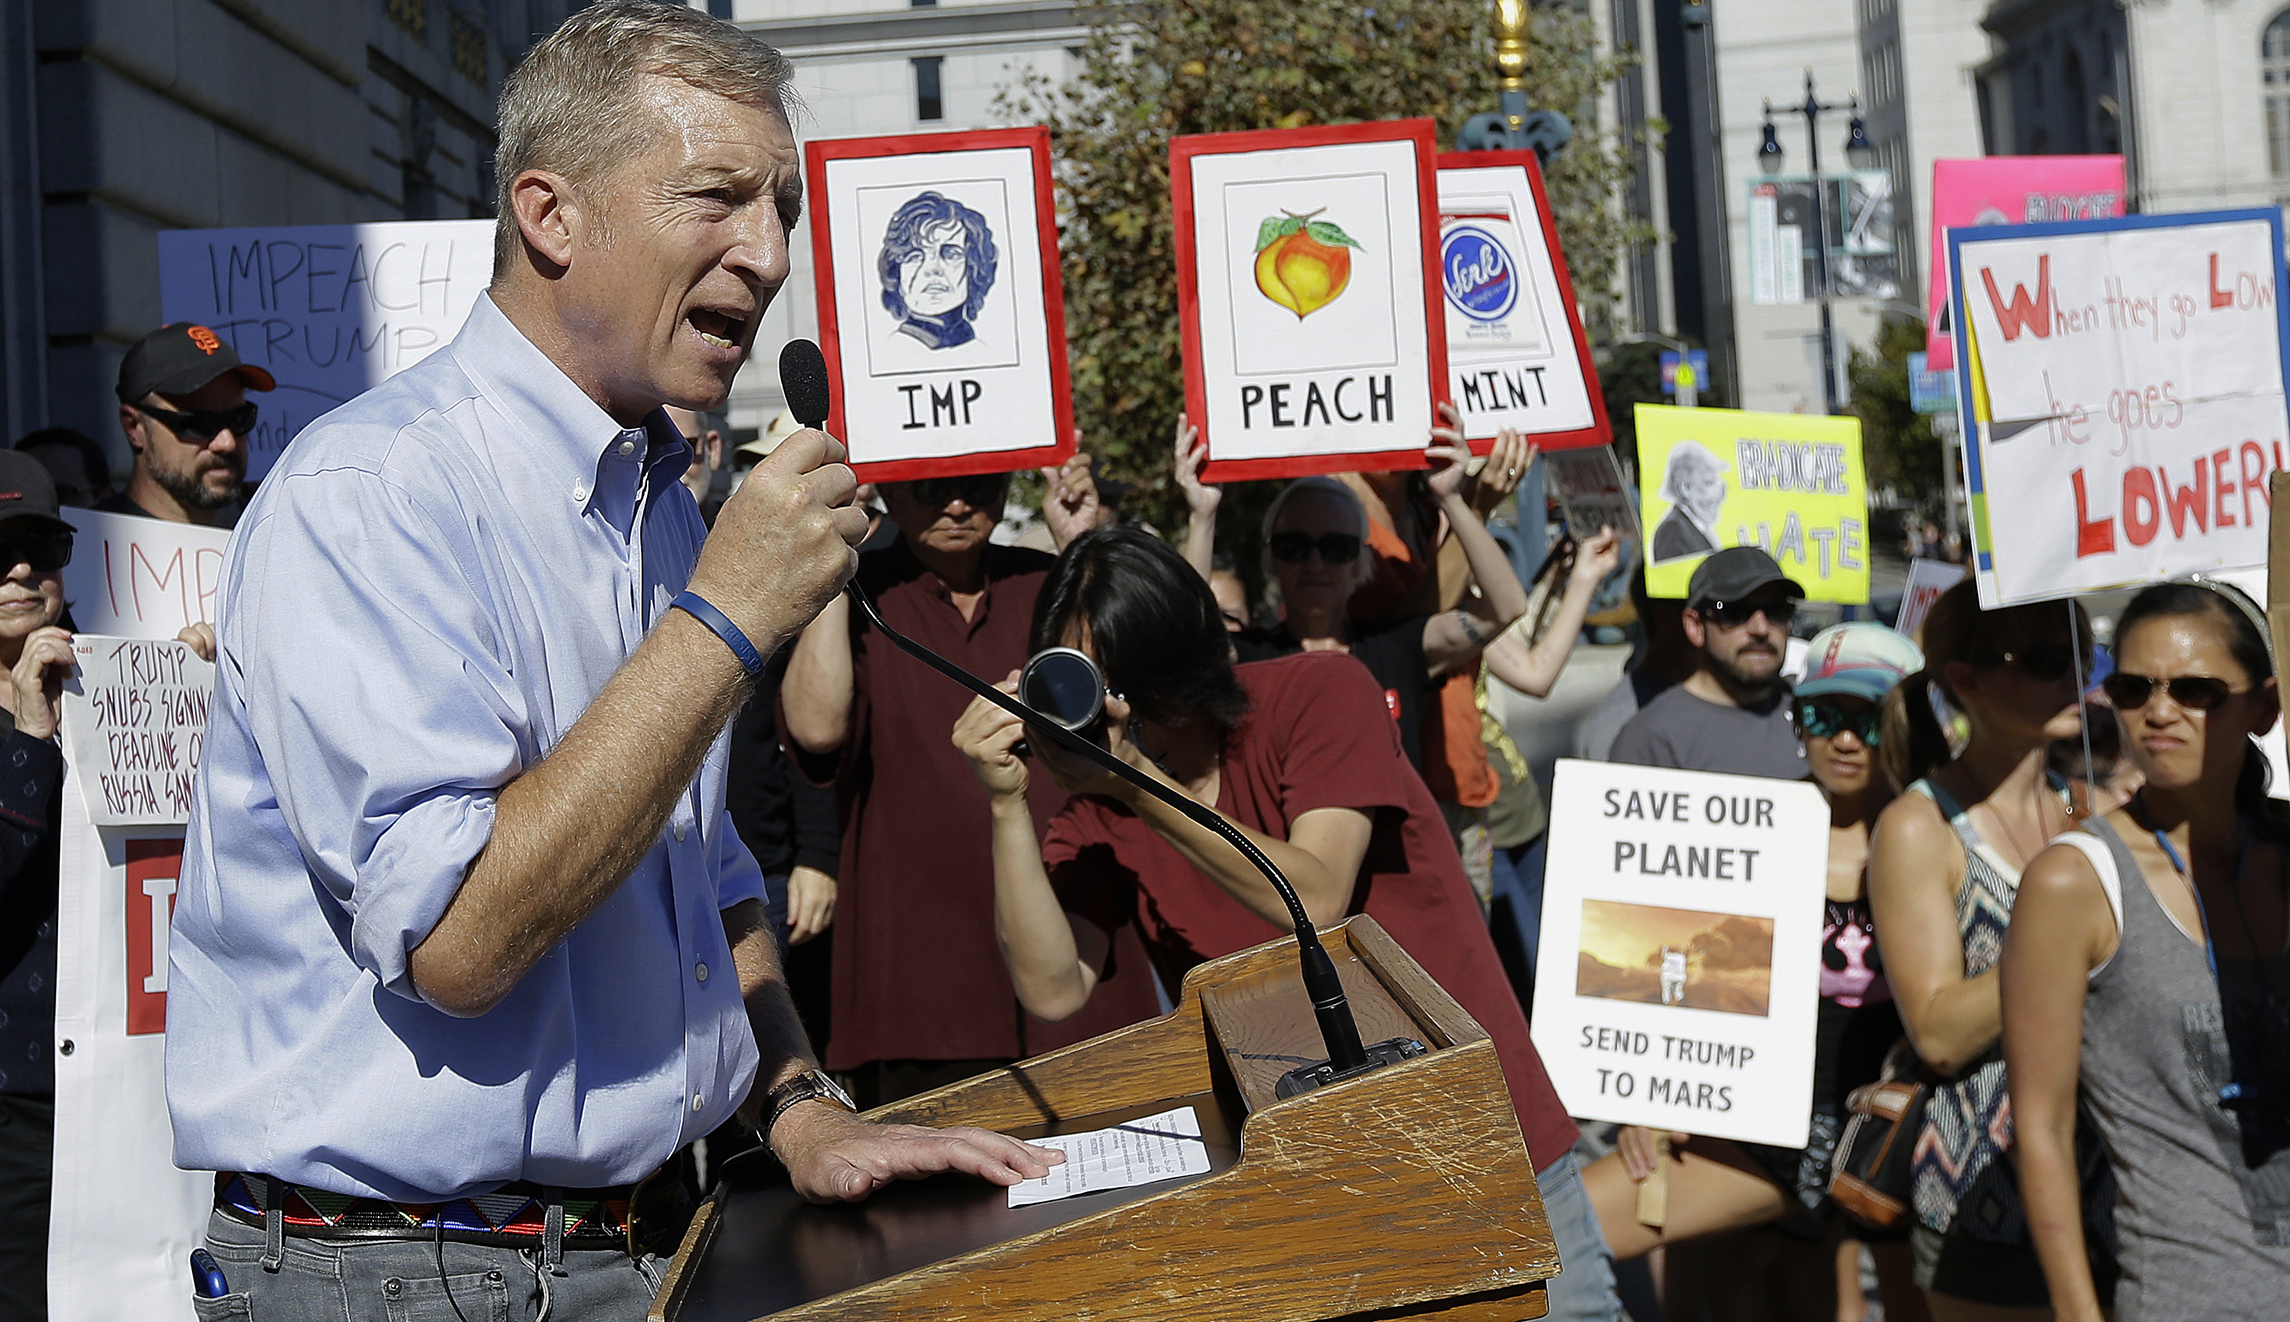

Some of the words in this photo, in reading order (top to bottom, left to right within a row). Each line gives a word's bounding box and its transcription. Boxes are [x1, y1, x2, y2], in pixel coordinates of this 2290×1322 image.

[208, 239, 454, 316] IMPEACH
[1980, 253, 2100, 342] When
[2104, 274, 2159, 343] they
[2169, 292, 2197, 340] go
[211, 317, 438, 371] TRUMP
[897, 379, 982, 430] IMP
[1241, 374, 1394, 430] PEACH
[1460, 366, 1547, 413] MINT
[2042, 369, 2092, 447] he
[2107, 379, 2184, 456] goes
[1737, 438, 1848, 495] ERADICATE
[109, 641, 187, 686] TRUMP
[91, 685, 152, 731] SNUBS
[161, 685, 212, 730] SIGNIN
[107, 729, 180, 772] DEADLINE
[188, 731, 204, 769] O
[99, 771, 161, 816] RUSSIA
[164, 768, 196, 820] SAN
[1603, 789, 1690, 822] SAVE
[1705, 795, 1774, 828] OUR
[1613, 841, 1760, 882] PLANET
[1580, 1025, 1649, 1056] SEND
[1661, 1035, 1755, 1070] TRUMP
[1597, 1068, 1635, 1098] TO
[1648, 1075, 1733, 1112] MARS
